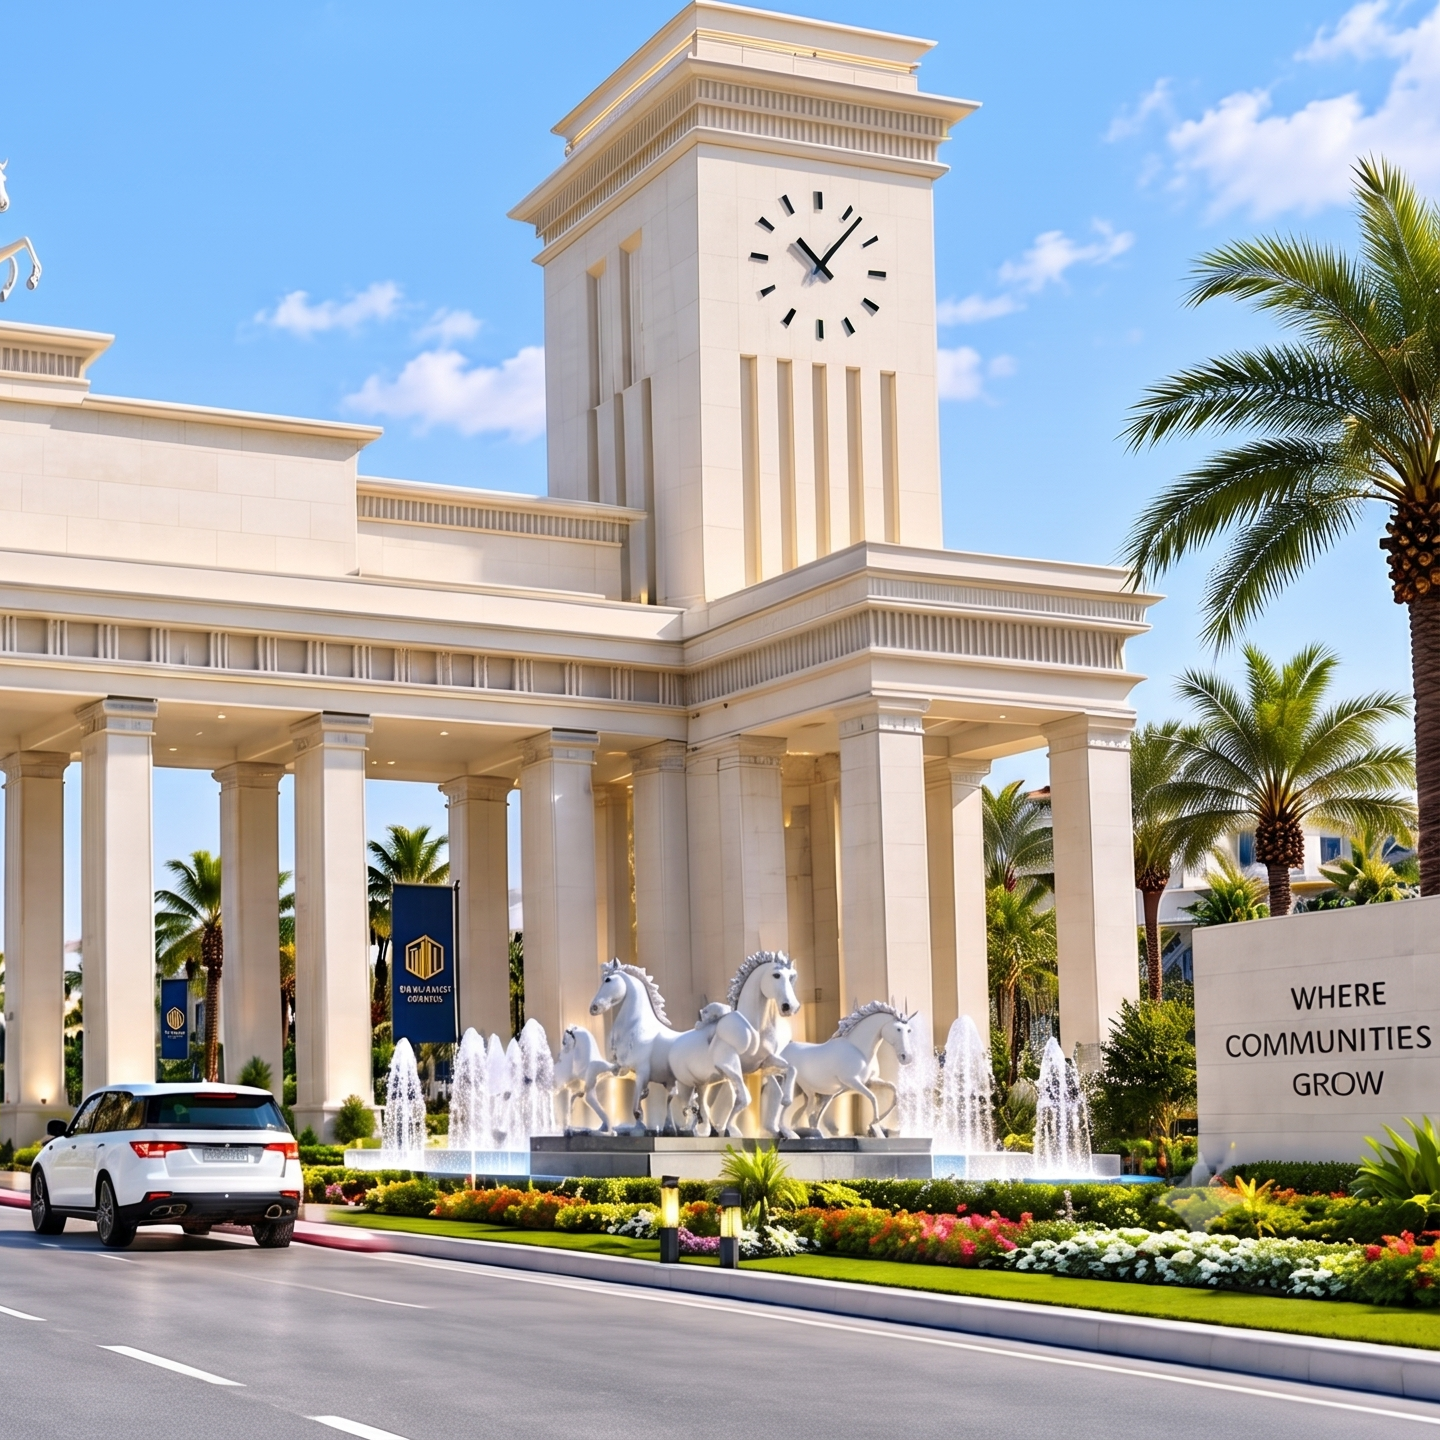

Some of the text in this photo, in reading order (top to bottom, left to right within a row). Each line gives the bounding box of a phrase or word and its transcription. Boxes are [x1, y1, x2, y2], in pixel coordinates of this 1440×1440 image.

[1290, 981, 1387, 1011] WHERE
[1225, 1025, 1432, 1058] COMMUNITIES
[1292, 1070, 1385, 1097] GROW
